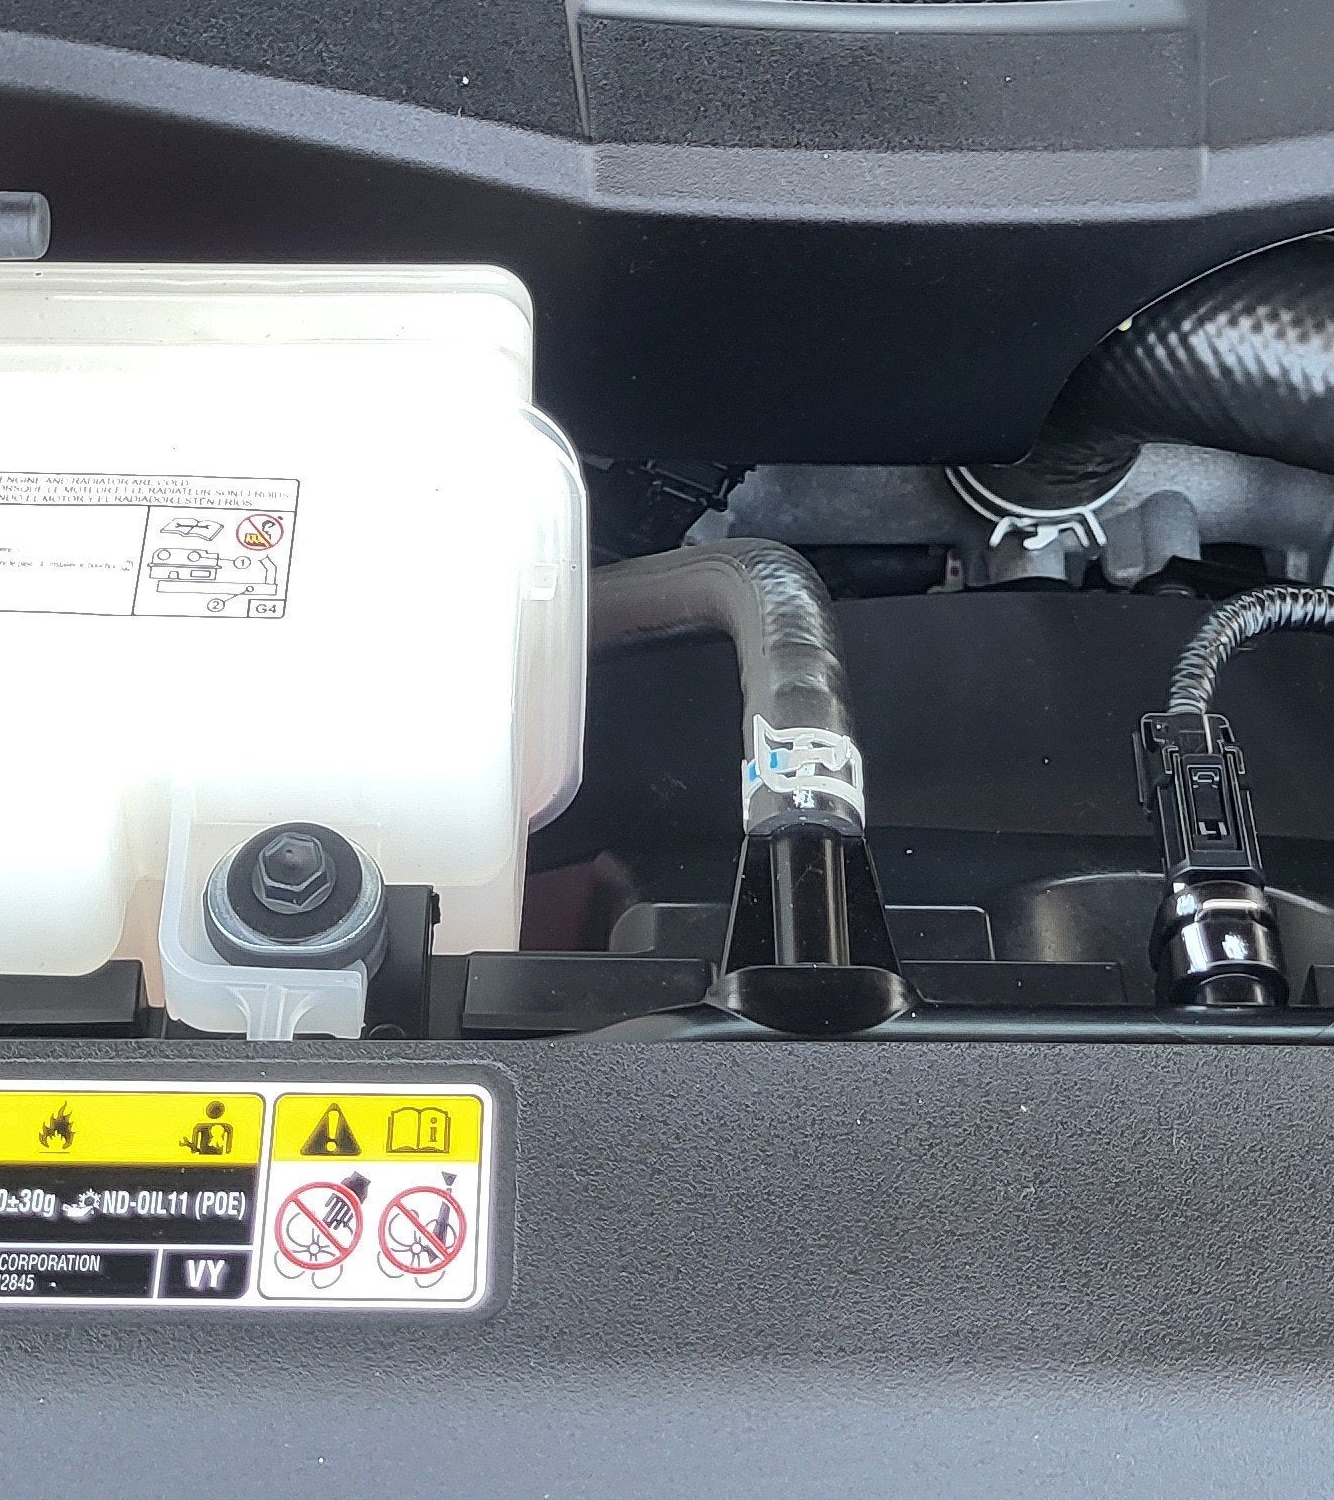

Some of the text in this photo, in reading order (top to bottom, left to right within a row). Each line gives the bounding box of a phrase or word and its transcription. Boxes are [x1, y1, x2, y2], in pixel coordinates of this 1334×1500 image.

[255, 603, 277, 614] G4
[194, 1191, 246, 1220] (POE)
[187, 1259, 225, 1288] VY
